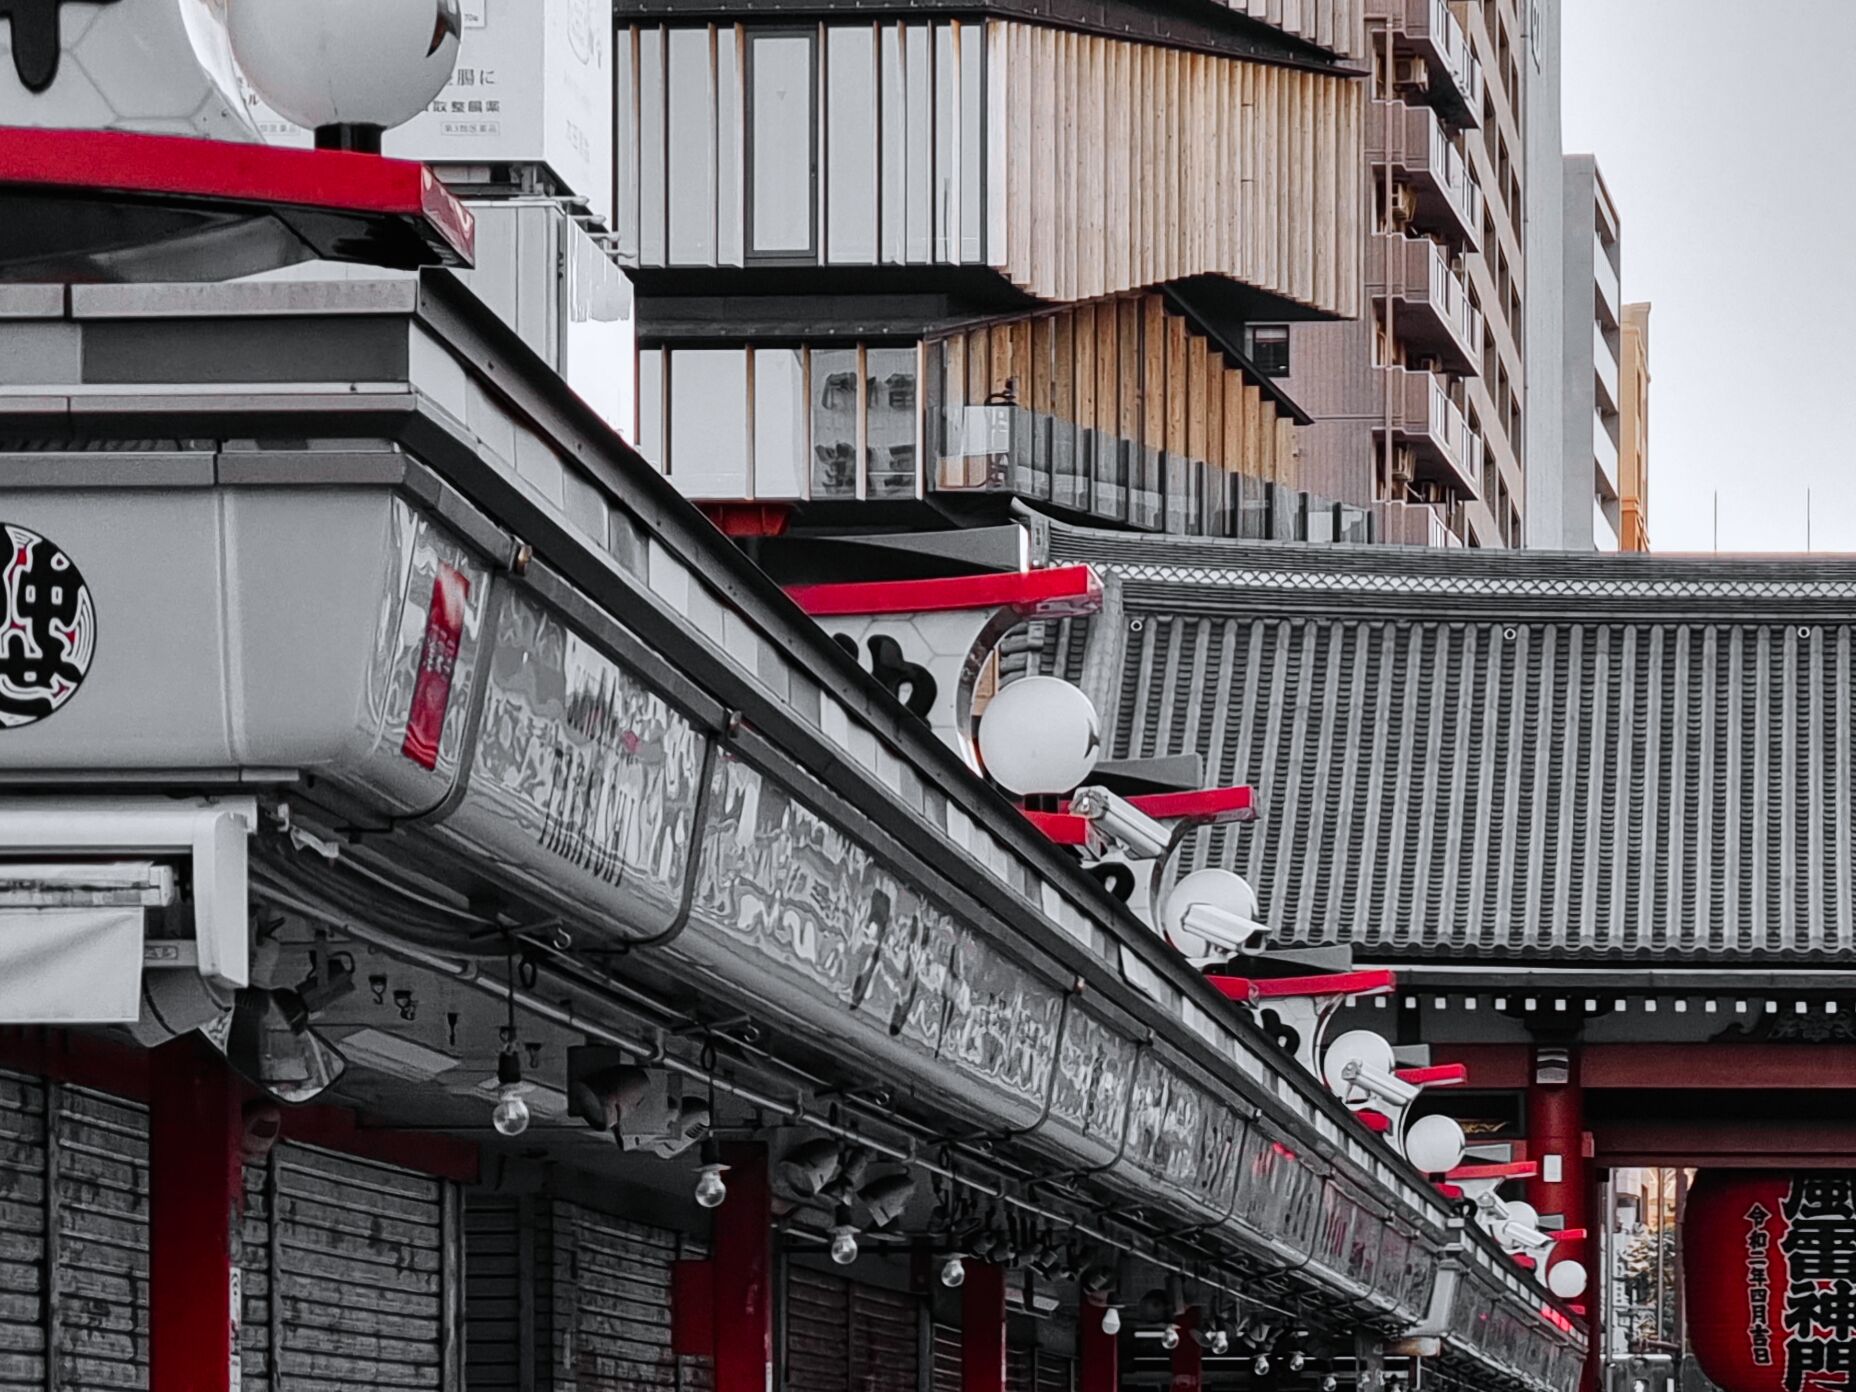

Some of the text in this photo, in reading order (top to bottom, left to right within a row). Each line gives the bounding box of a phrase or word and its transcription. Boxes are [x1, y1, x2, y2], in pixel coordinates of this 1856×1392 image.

[448, 68, 495, 87] 腸に
[1744, 1202, 1773, 1366] 令和二年四月吉日
